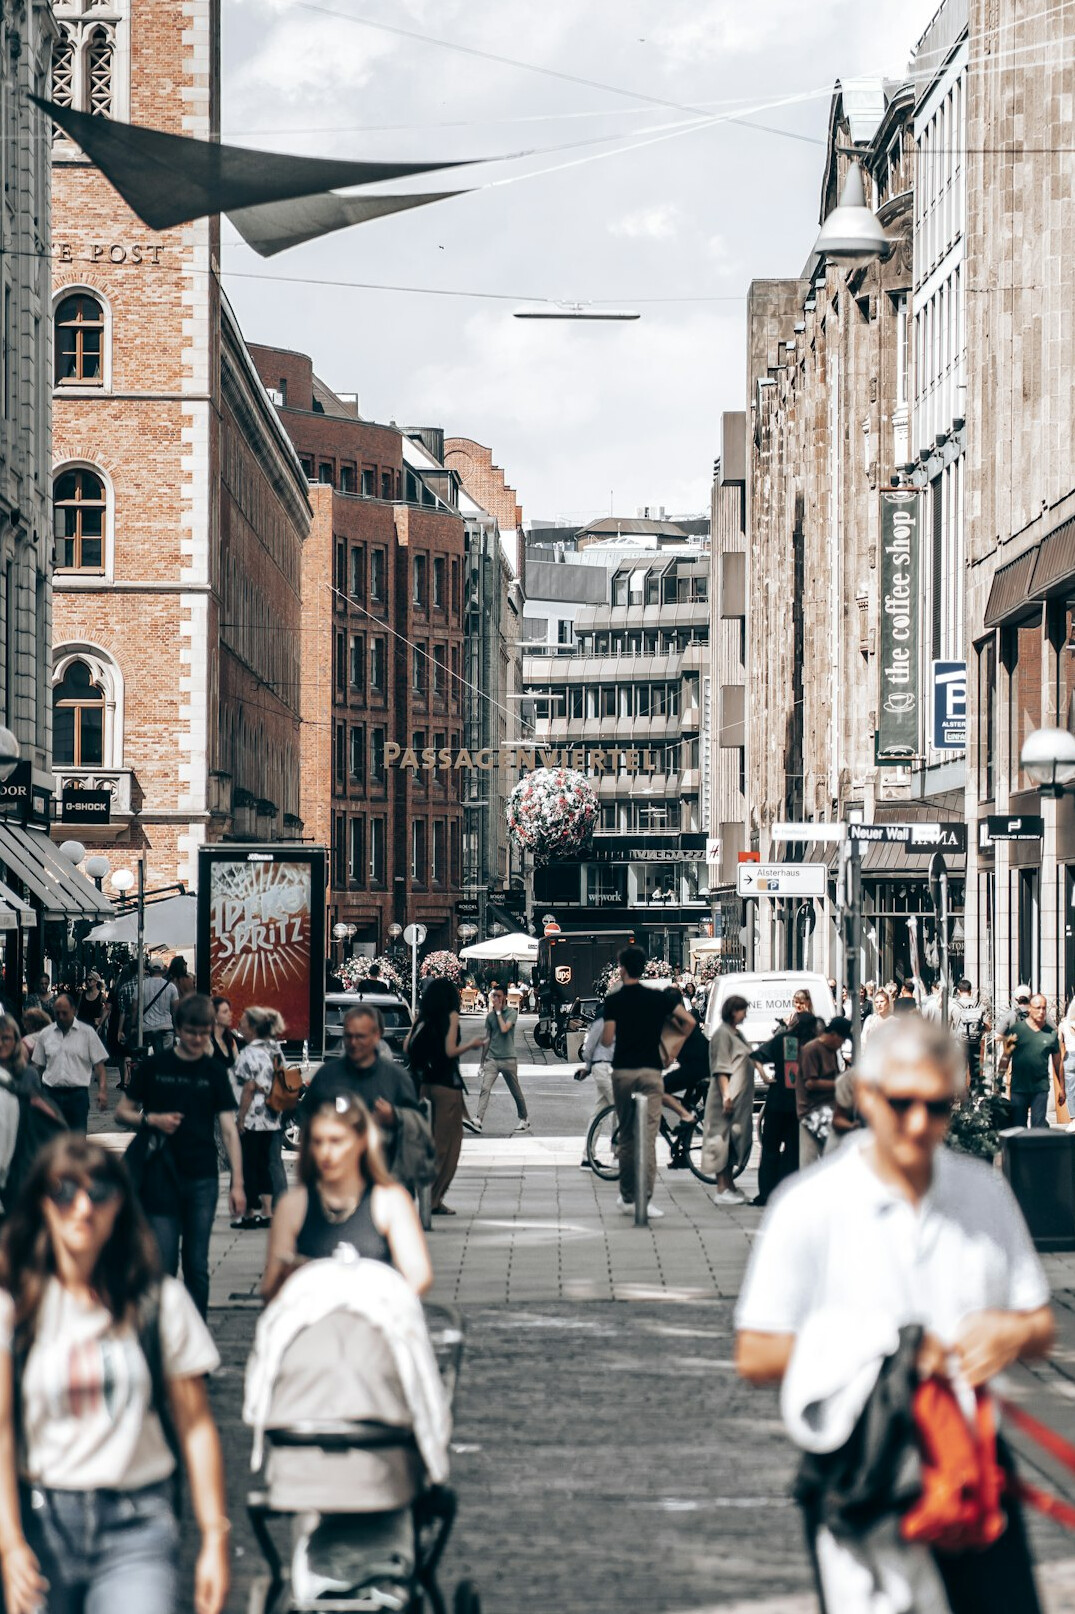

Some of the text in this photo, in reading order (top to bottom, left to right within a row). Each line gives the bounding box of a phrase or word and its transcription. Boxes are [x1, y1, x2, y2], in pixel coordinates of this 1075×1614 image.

[52, 243, 165, 265] E POST
[884, 511, 916, 684] the coffee shop
[383, 741, 656, 771] PASSAGENVIERTEL
[66, 803, 106, 811] G-SHOCK
[851, 827, 909, 841] Neuer Wall
[757, 868, 800, 877] Alsterhaus
[588, 890, 622, 902] wework
